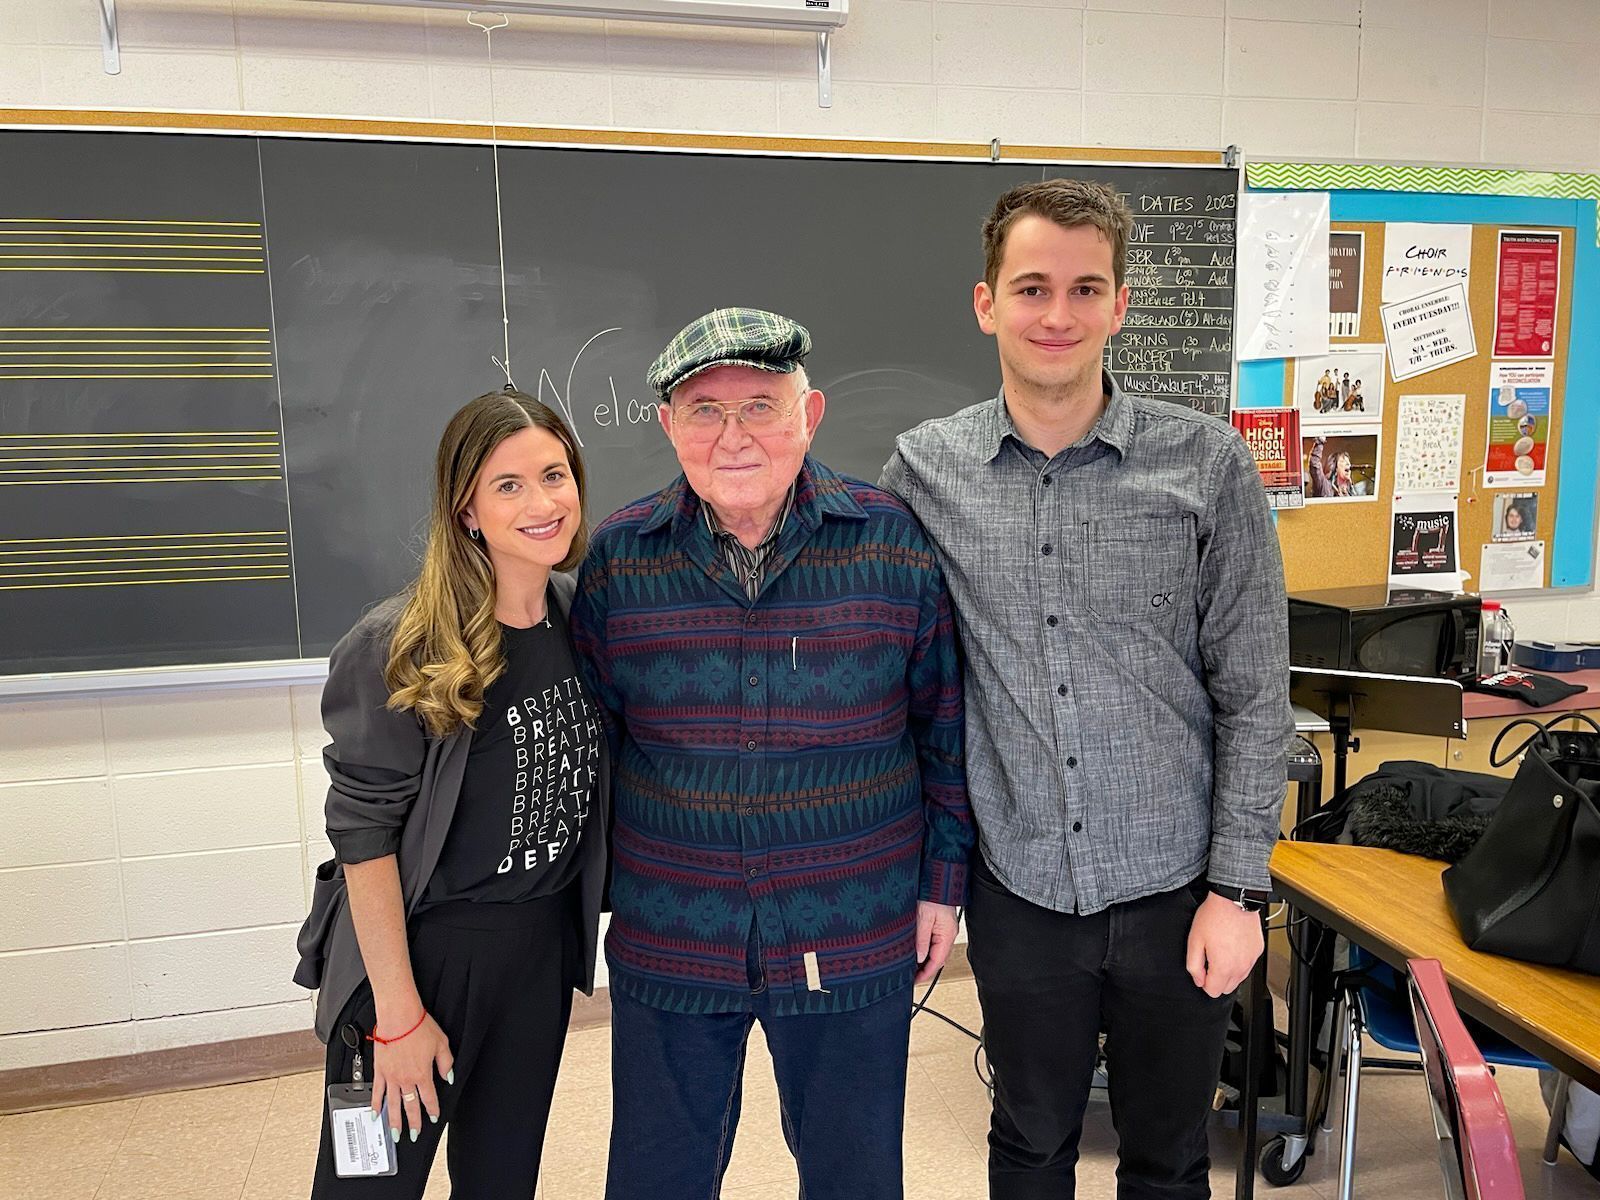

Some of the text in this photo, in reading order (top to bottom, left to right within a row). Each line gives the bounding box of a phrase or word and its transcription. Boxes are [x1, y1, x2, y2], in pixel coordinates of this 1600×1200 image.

[1139, 194, 1194, 213] DATES
[1204, 193, 1236, 212] 2023
[1210, 248, 1235, 266] Aud
[1329, 247, 1357, 257] ORATION
[1405, 245, 1448, 260] CHOIR
[1124, 275, 1163, 286] HOWCASE
[1329, 269, 1342, 278] HIP
[1329, 281, 1344, 290] TION
[1393, 302, 1460, 331] EVERY TUESDAY!!!
[1398, 305, 1420, 317] CHORAL
[1121, 333, 1168, 346] SPRING
[1209, 336, 1231, 352] Aud
[1412, 344, 1425, 356] S/A
[1432, 336, 1452, 349] WED.
[1118, 347, 1180, 364] CONCERT
[1409, 354, 1422, 366] T/B
[1430, 343, 1458, 358] THURS.
[1246, 427, 1285, 441] HIGH
[1247, 440, 1285, 451] SCHOOL
[1251, 450, 1286, 460] USICAL
[1416, 514, 1449, 529] music
[1151, 592, 1173, 608] CK
[516, 718, 602, 769] BREATH
[511, 789, 591, 837] BREAT
